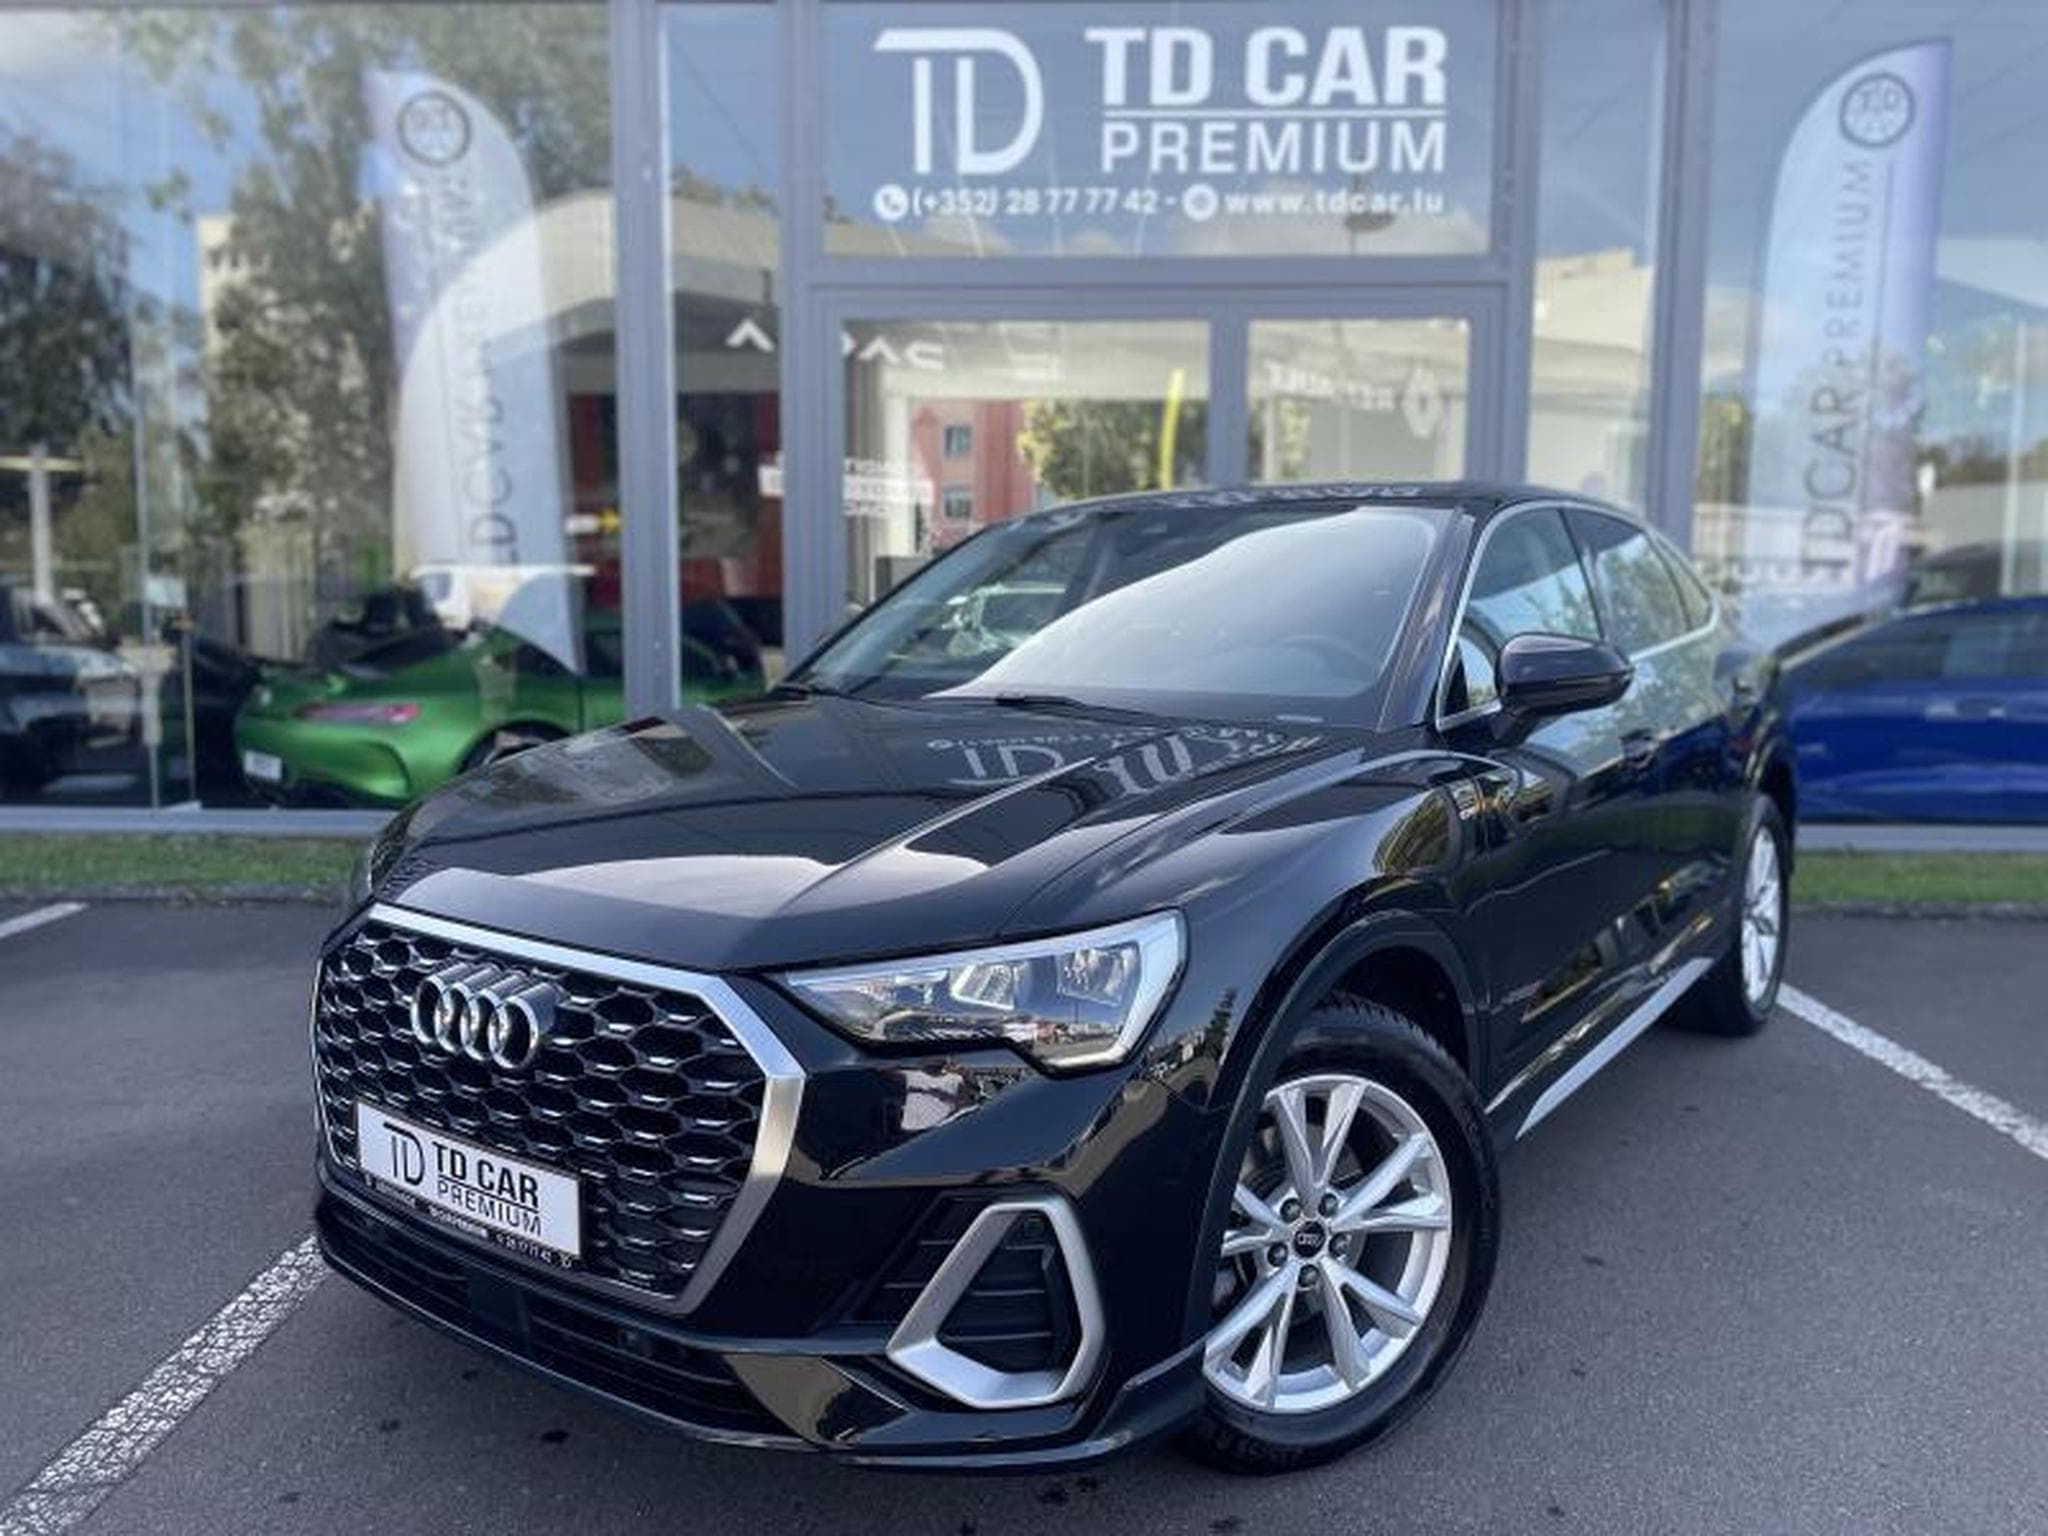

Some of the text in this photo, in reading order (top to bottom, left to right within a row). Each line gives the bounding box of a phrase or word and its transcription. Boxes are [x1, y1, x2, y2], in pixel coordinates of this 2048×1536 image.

[1085, 25, 1448, 108] TD CAR
[1102, 120, 1446, 174] PREMIUM
[912, 187, 999, 216] (+352)
[1005, 188, 1040, 216] 28
[1045, 188, 1078, 215] 77
[1084, 188, 1118, 215] 77
[1121, 188, 1158, 215] 42
[1224, 188, 1445, 215] www.tdcar.lu
[1822, 158, 1873, 370] PREMIUM
[432, 1141, 539, 1209] TD CAR
[437, 1179, 542, 1237] PREMIUM
